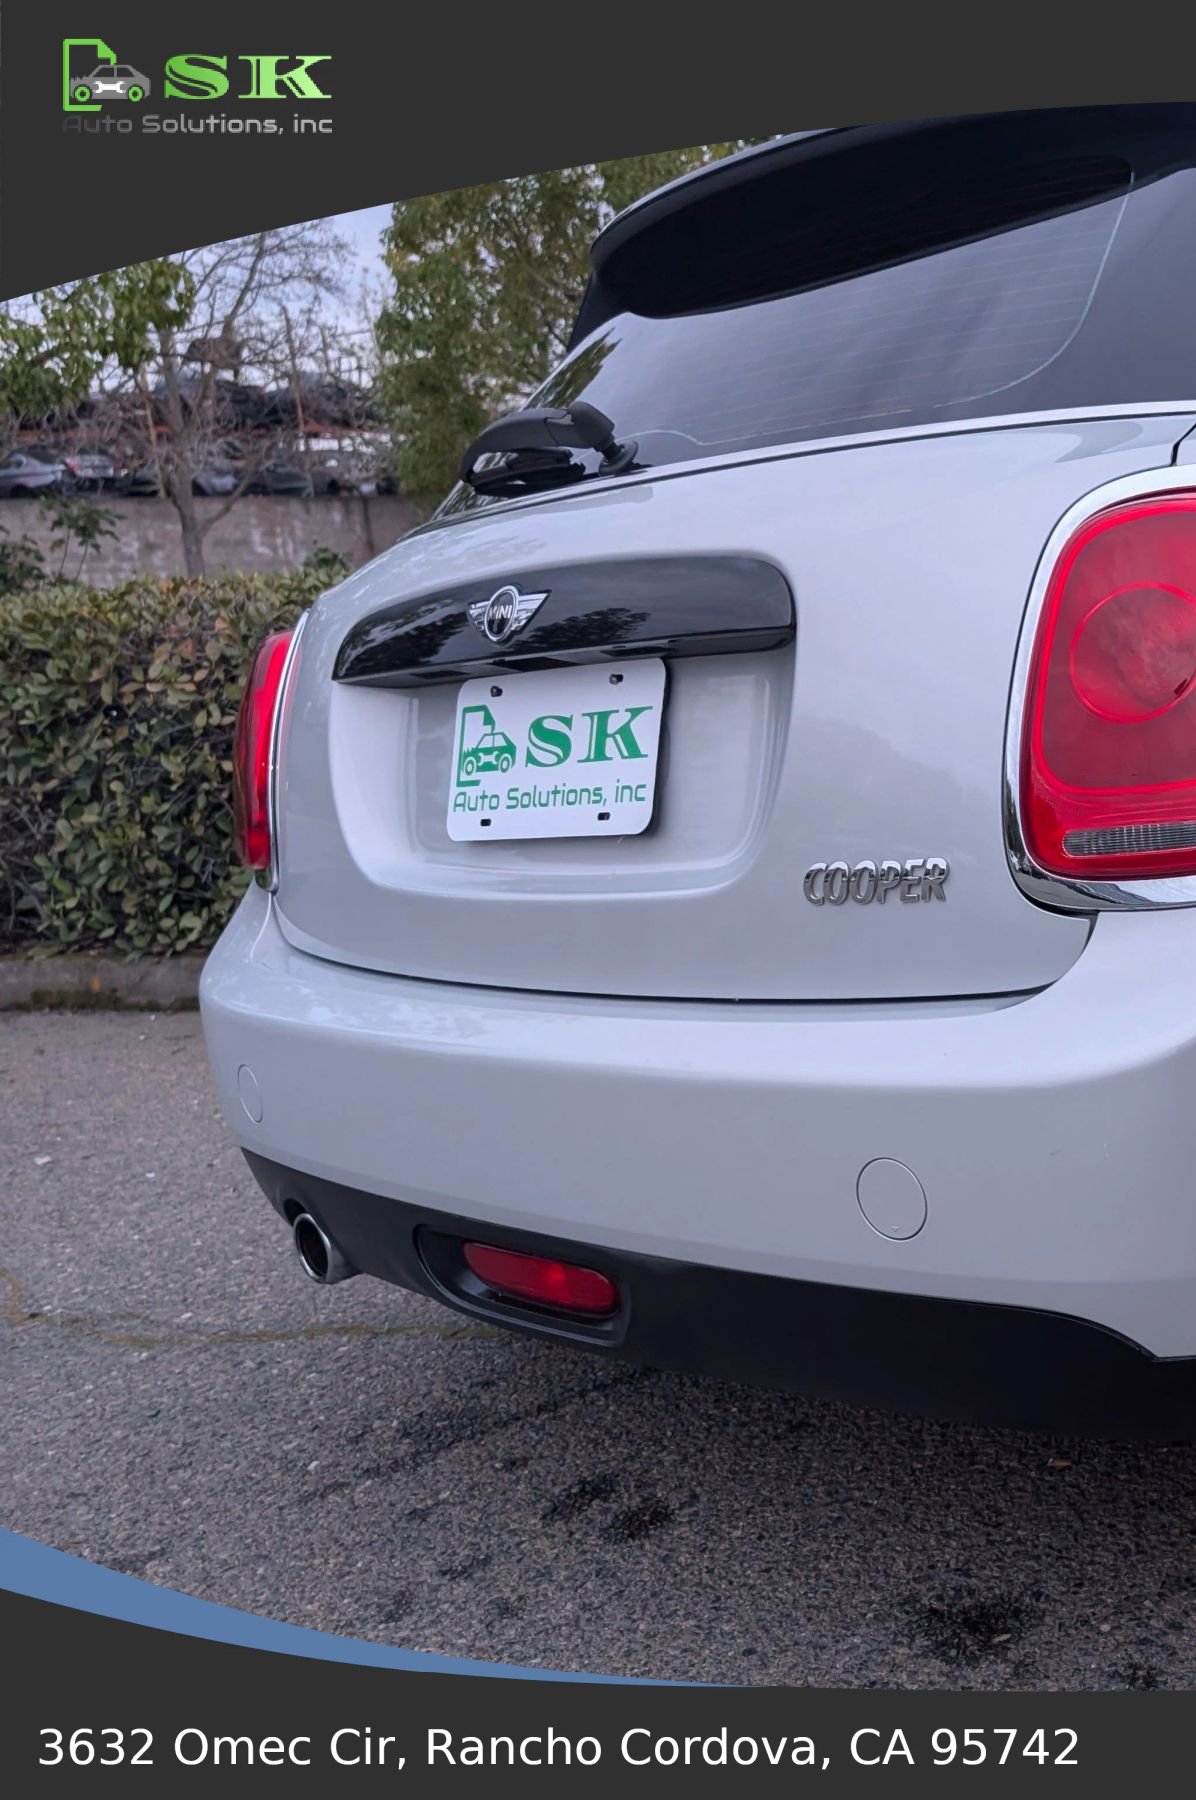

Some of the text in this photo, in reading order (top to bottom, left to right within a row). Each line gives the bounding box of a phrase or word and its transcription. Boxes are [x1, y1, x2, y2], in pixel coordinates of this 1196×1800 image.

[487, 604, 513, 621] MINI
[525, 705, 654, 769] SK
[453, 778, 647, 813] Auto Solutions, inc
[803, 856, 950, 907] COOPER
